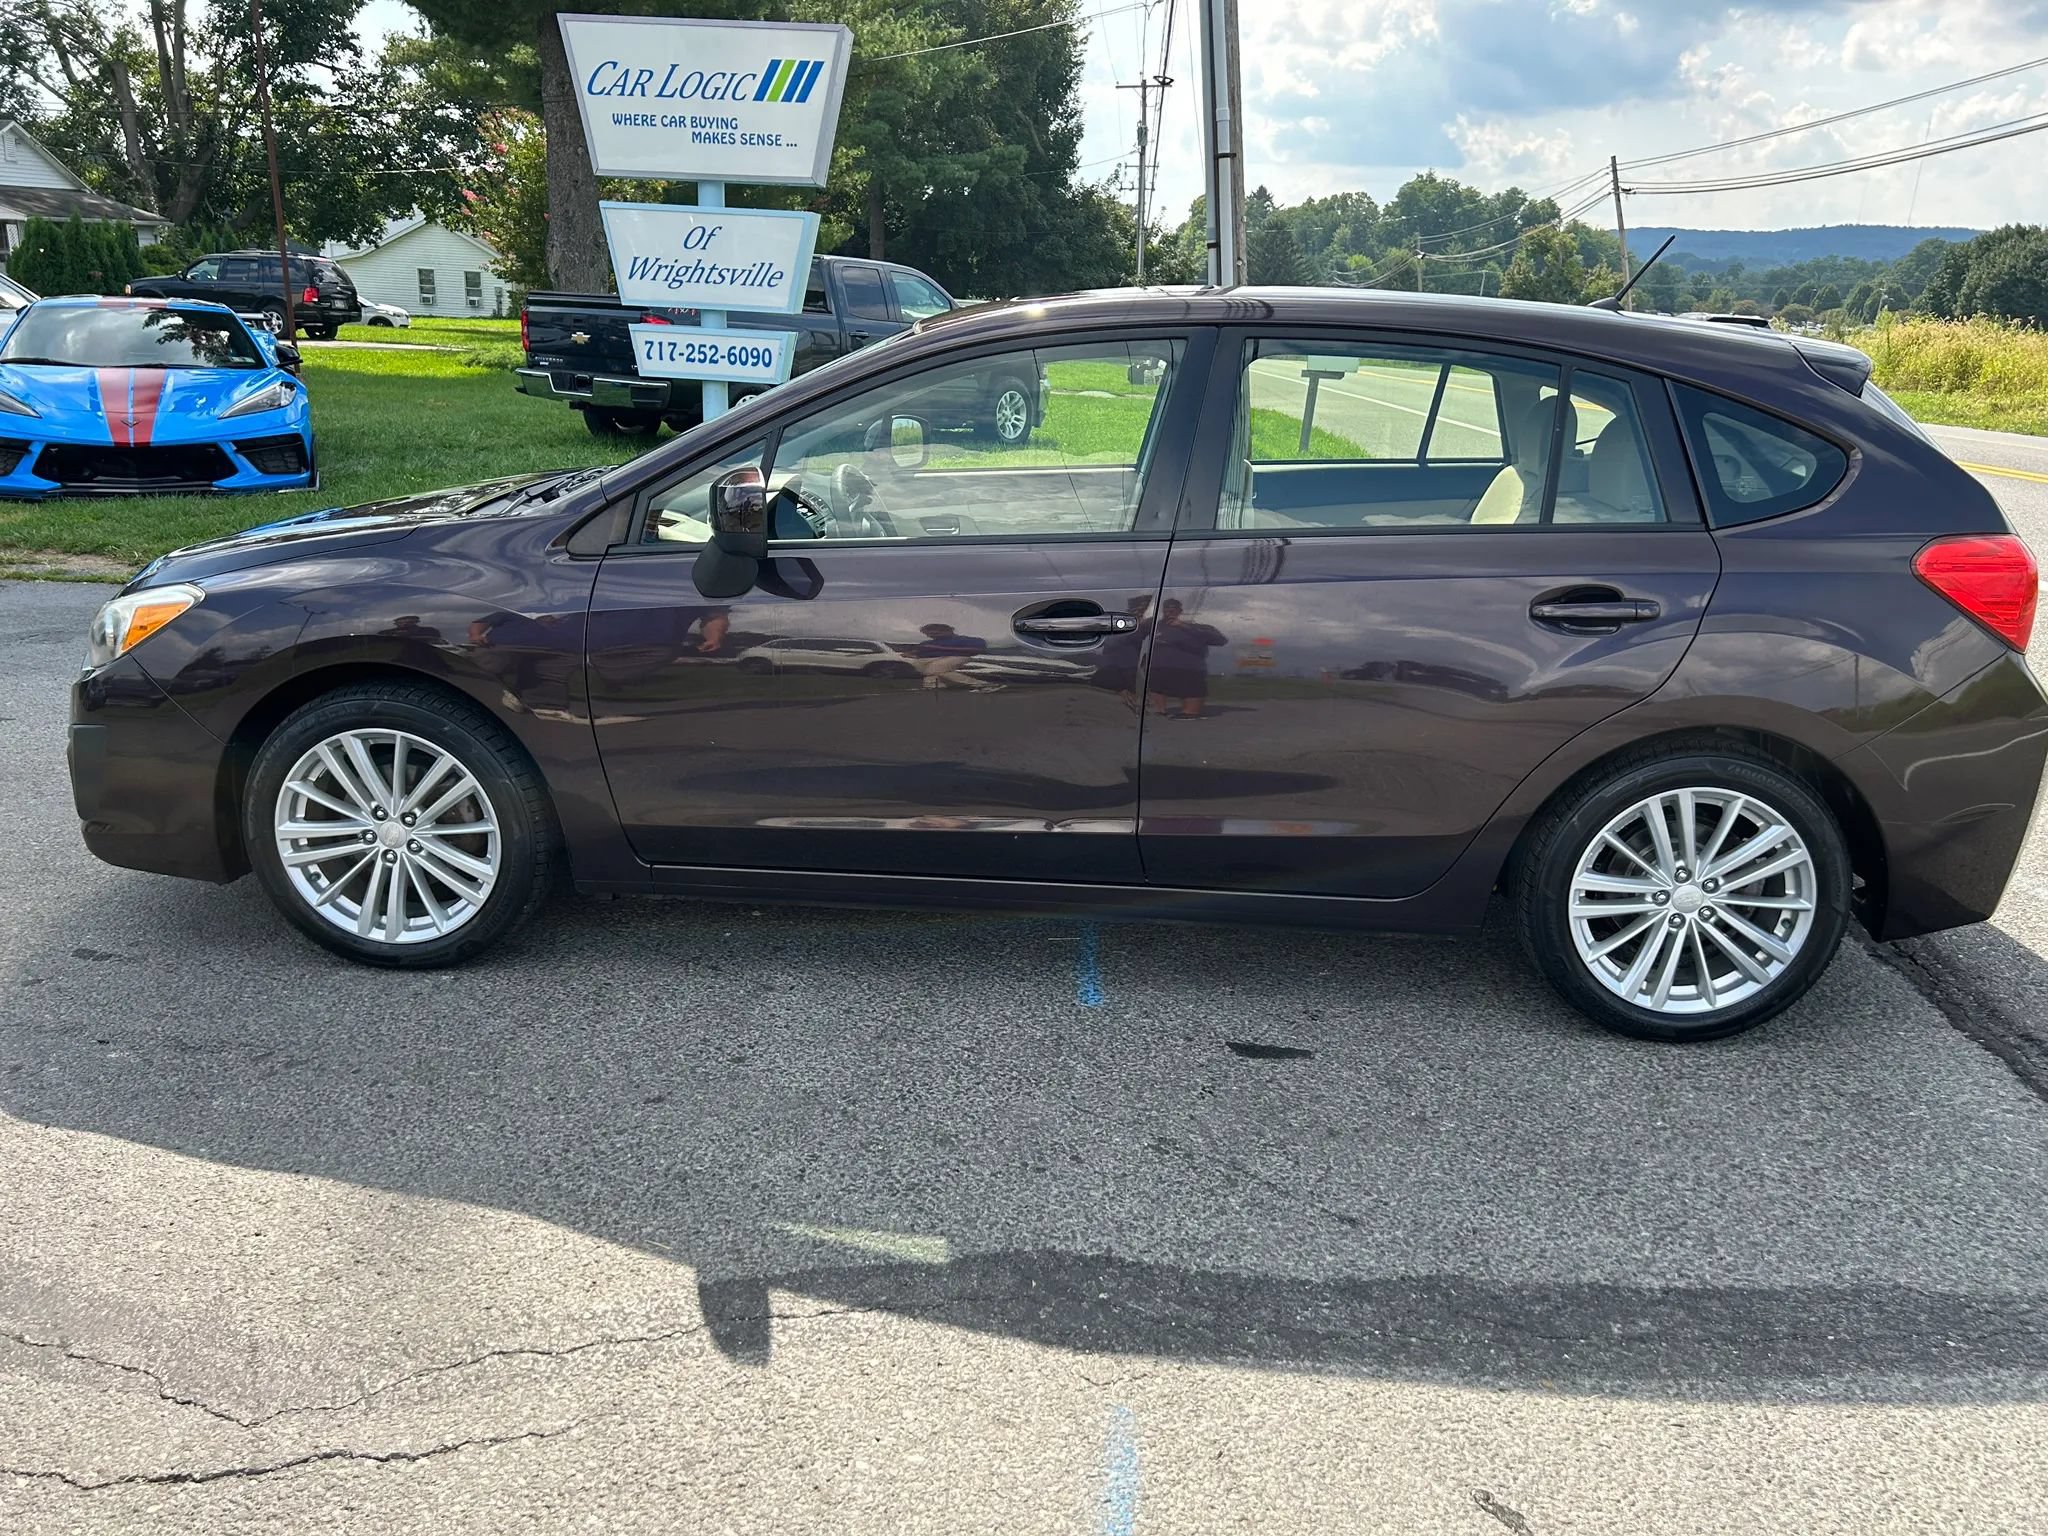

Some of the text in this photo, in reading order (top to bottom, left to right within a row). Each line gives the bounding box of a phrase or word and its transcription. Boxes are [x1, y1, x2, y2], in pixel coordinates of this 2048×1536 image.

[587, 61, 756, 101] CAR LOGIC
[612, 113, 738, 130] WHERE CAR BUYING
[691, 132, 736, 145] MAKES
[740, 133, 783, 147] SENSE
[683, 226, 723, 250] Of
[628, 256, 784, 290] Wrightsville
[644, 340, 773, 368] 717-252-6090
